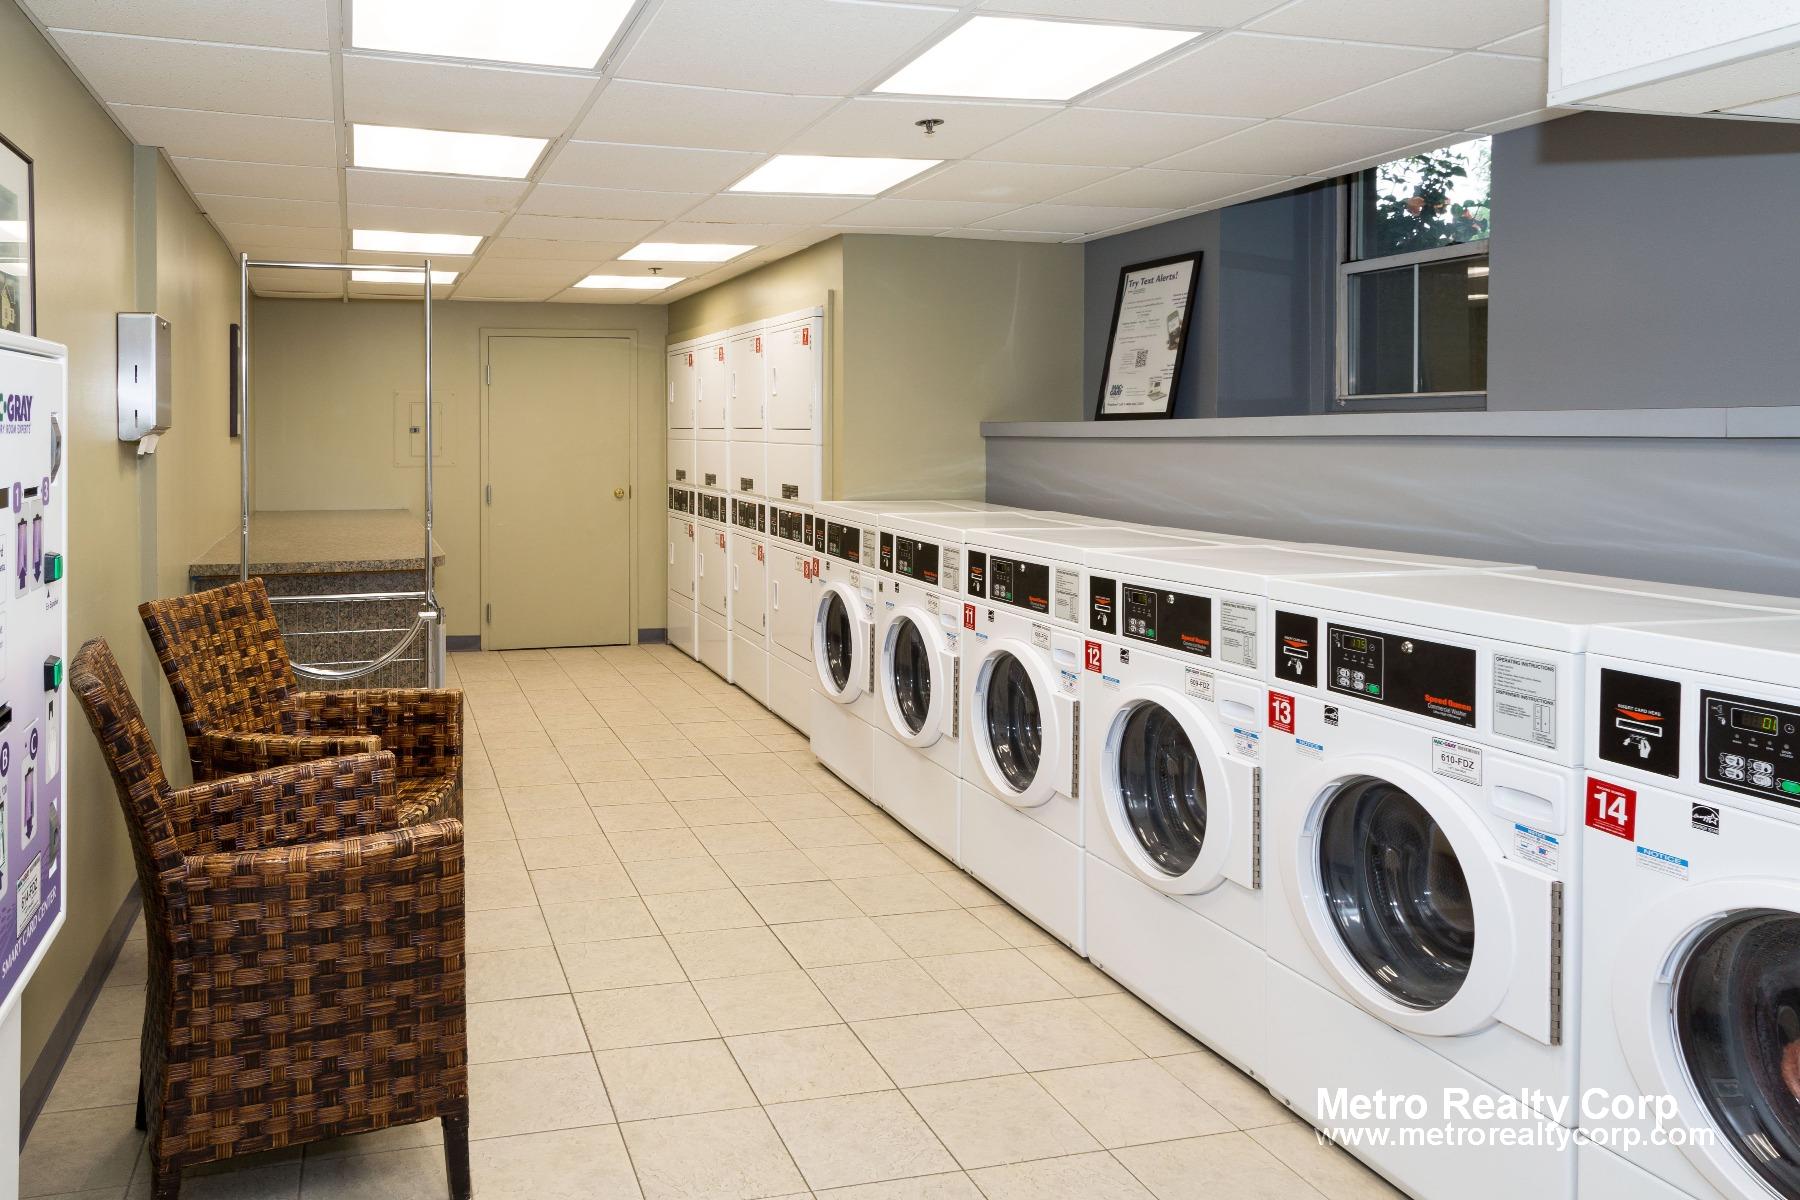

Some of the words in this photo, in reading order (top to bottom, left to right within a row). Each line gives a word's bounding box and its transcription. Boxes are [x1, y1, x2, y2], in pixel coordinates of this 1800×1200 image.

[1128, 279, 1139, 290] Try
[1141, 276, 1155, 286] Text
[1156, 271, 1179, 283] Alerts!
[965, 607, 975, 624] 11
[1087, 647, 1099, 666] 12
[1495, 656, 1521, 666] OPERATING
[1521, 660, 1555, 672] INSTRUCTIONS
[1424, 694, 1448, 706] Speed
[1520, 693, 1554, 706] INSTRUCTIONS
[1272, 700, 1291, 725] 13
[1440, 753, 1475, 770] 610-FDZ
[1593, 791, 1628, 826] 14
[1643, 848, 1681, 864] NOTICE
[1, 937, 22, 979] SMART
[22, 912, 38, 945] CARD
[38, 885, 57, 921] CENTER
